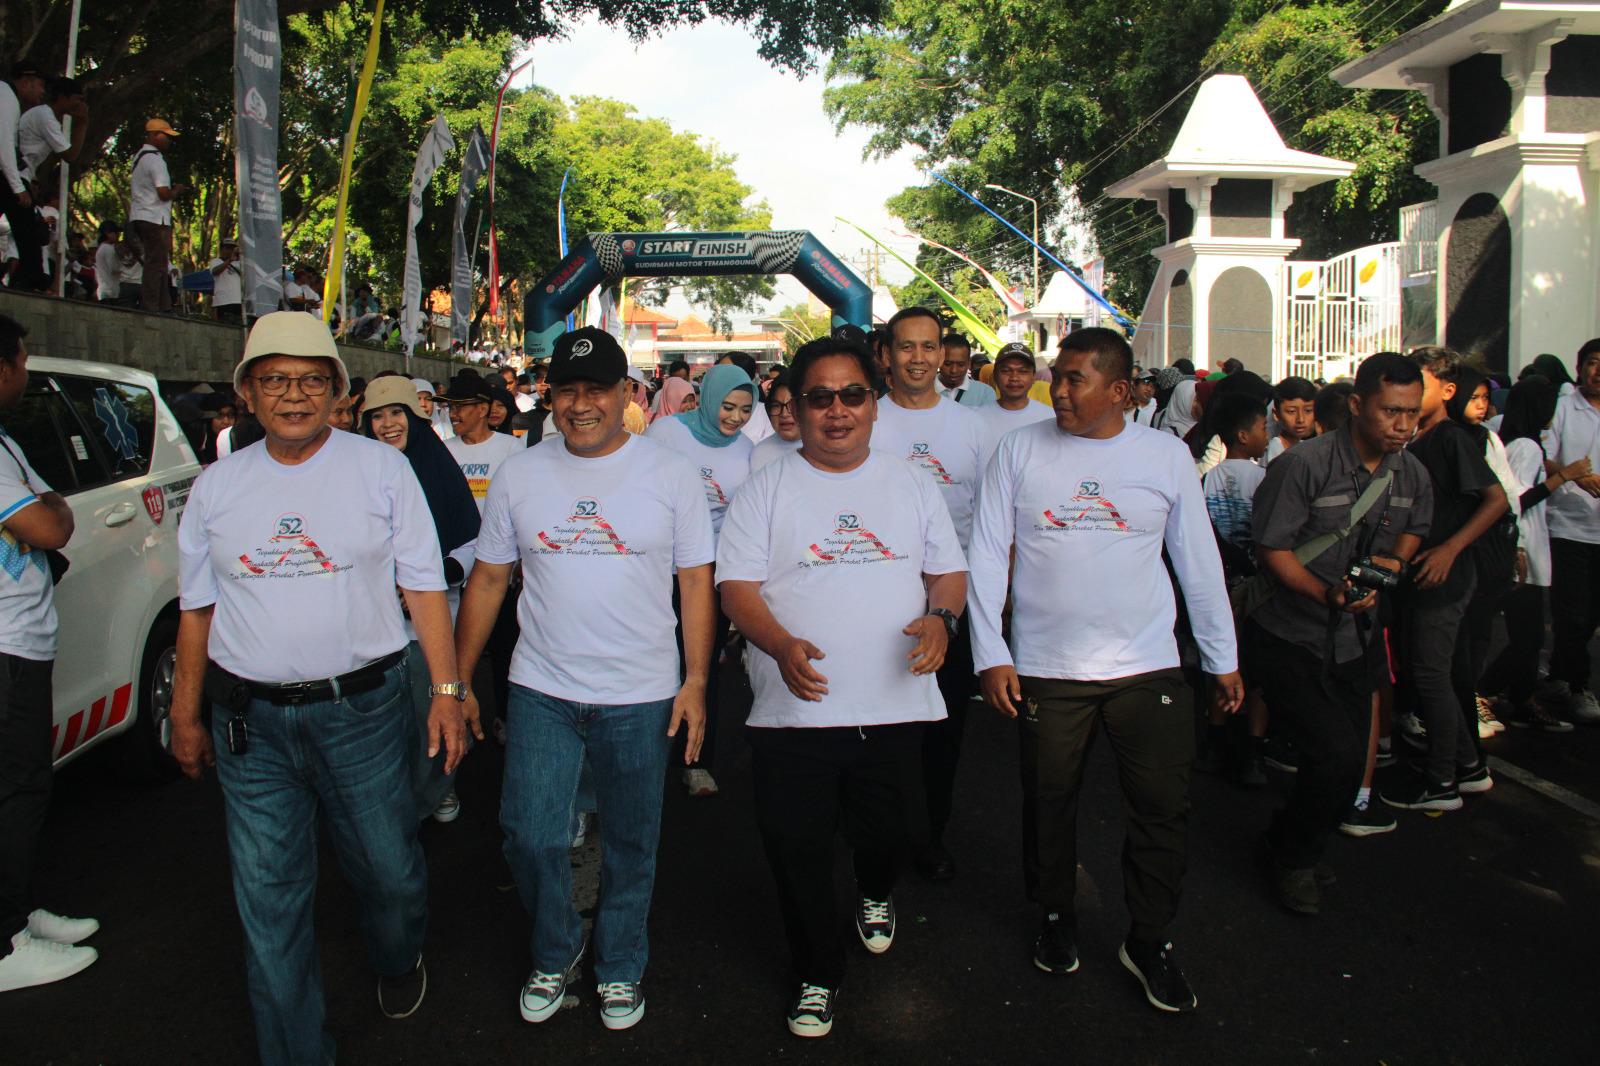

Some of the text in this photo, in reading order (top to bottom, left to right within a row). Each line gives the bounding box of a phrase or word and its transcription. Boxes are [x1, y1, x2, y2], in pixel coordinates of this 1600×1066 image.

[643, 240, 693, 254] START
[698, 242, 747, 255] FINISH
[552, 255, 586, 286] YAMAHA
[635, 259, 757, 269] SUDIRMAN MOTOR TEMANGGUNG
[819, 256, 851, 289] YAMAHA
[912, 443, 930, 455] 52
[460, 463, 490, 476] ORPRI
[700, 467, 713, 479] 52
[1079, 481, 1100, 495] 52
[147, 494, 163, 514] 119
[575, 501, 598, 515] 52
[278, 518, 303, 535] 52
[839, 515, 859, 528] 52
